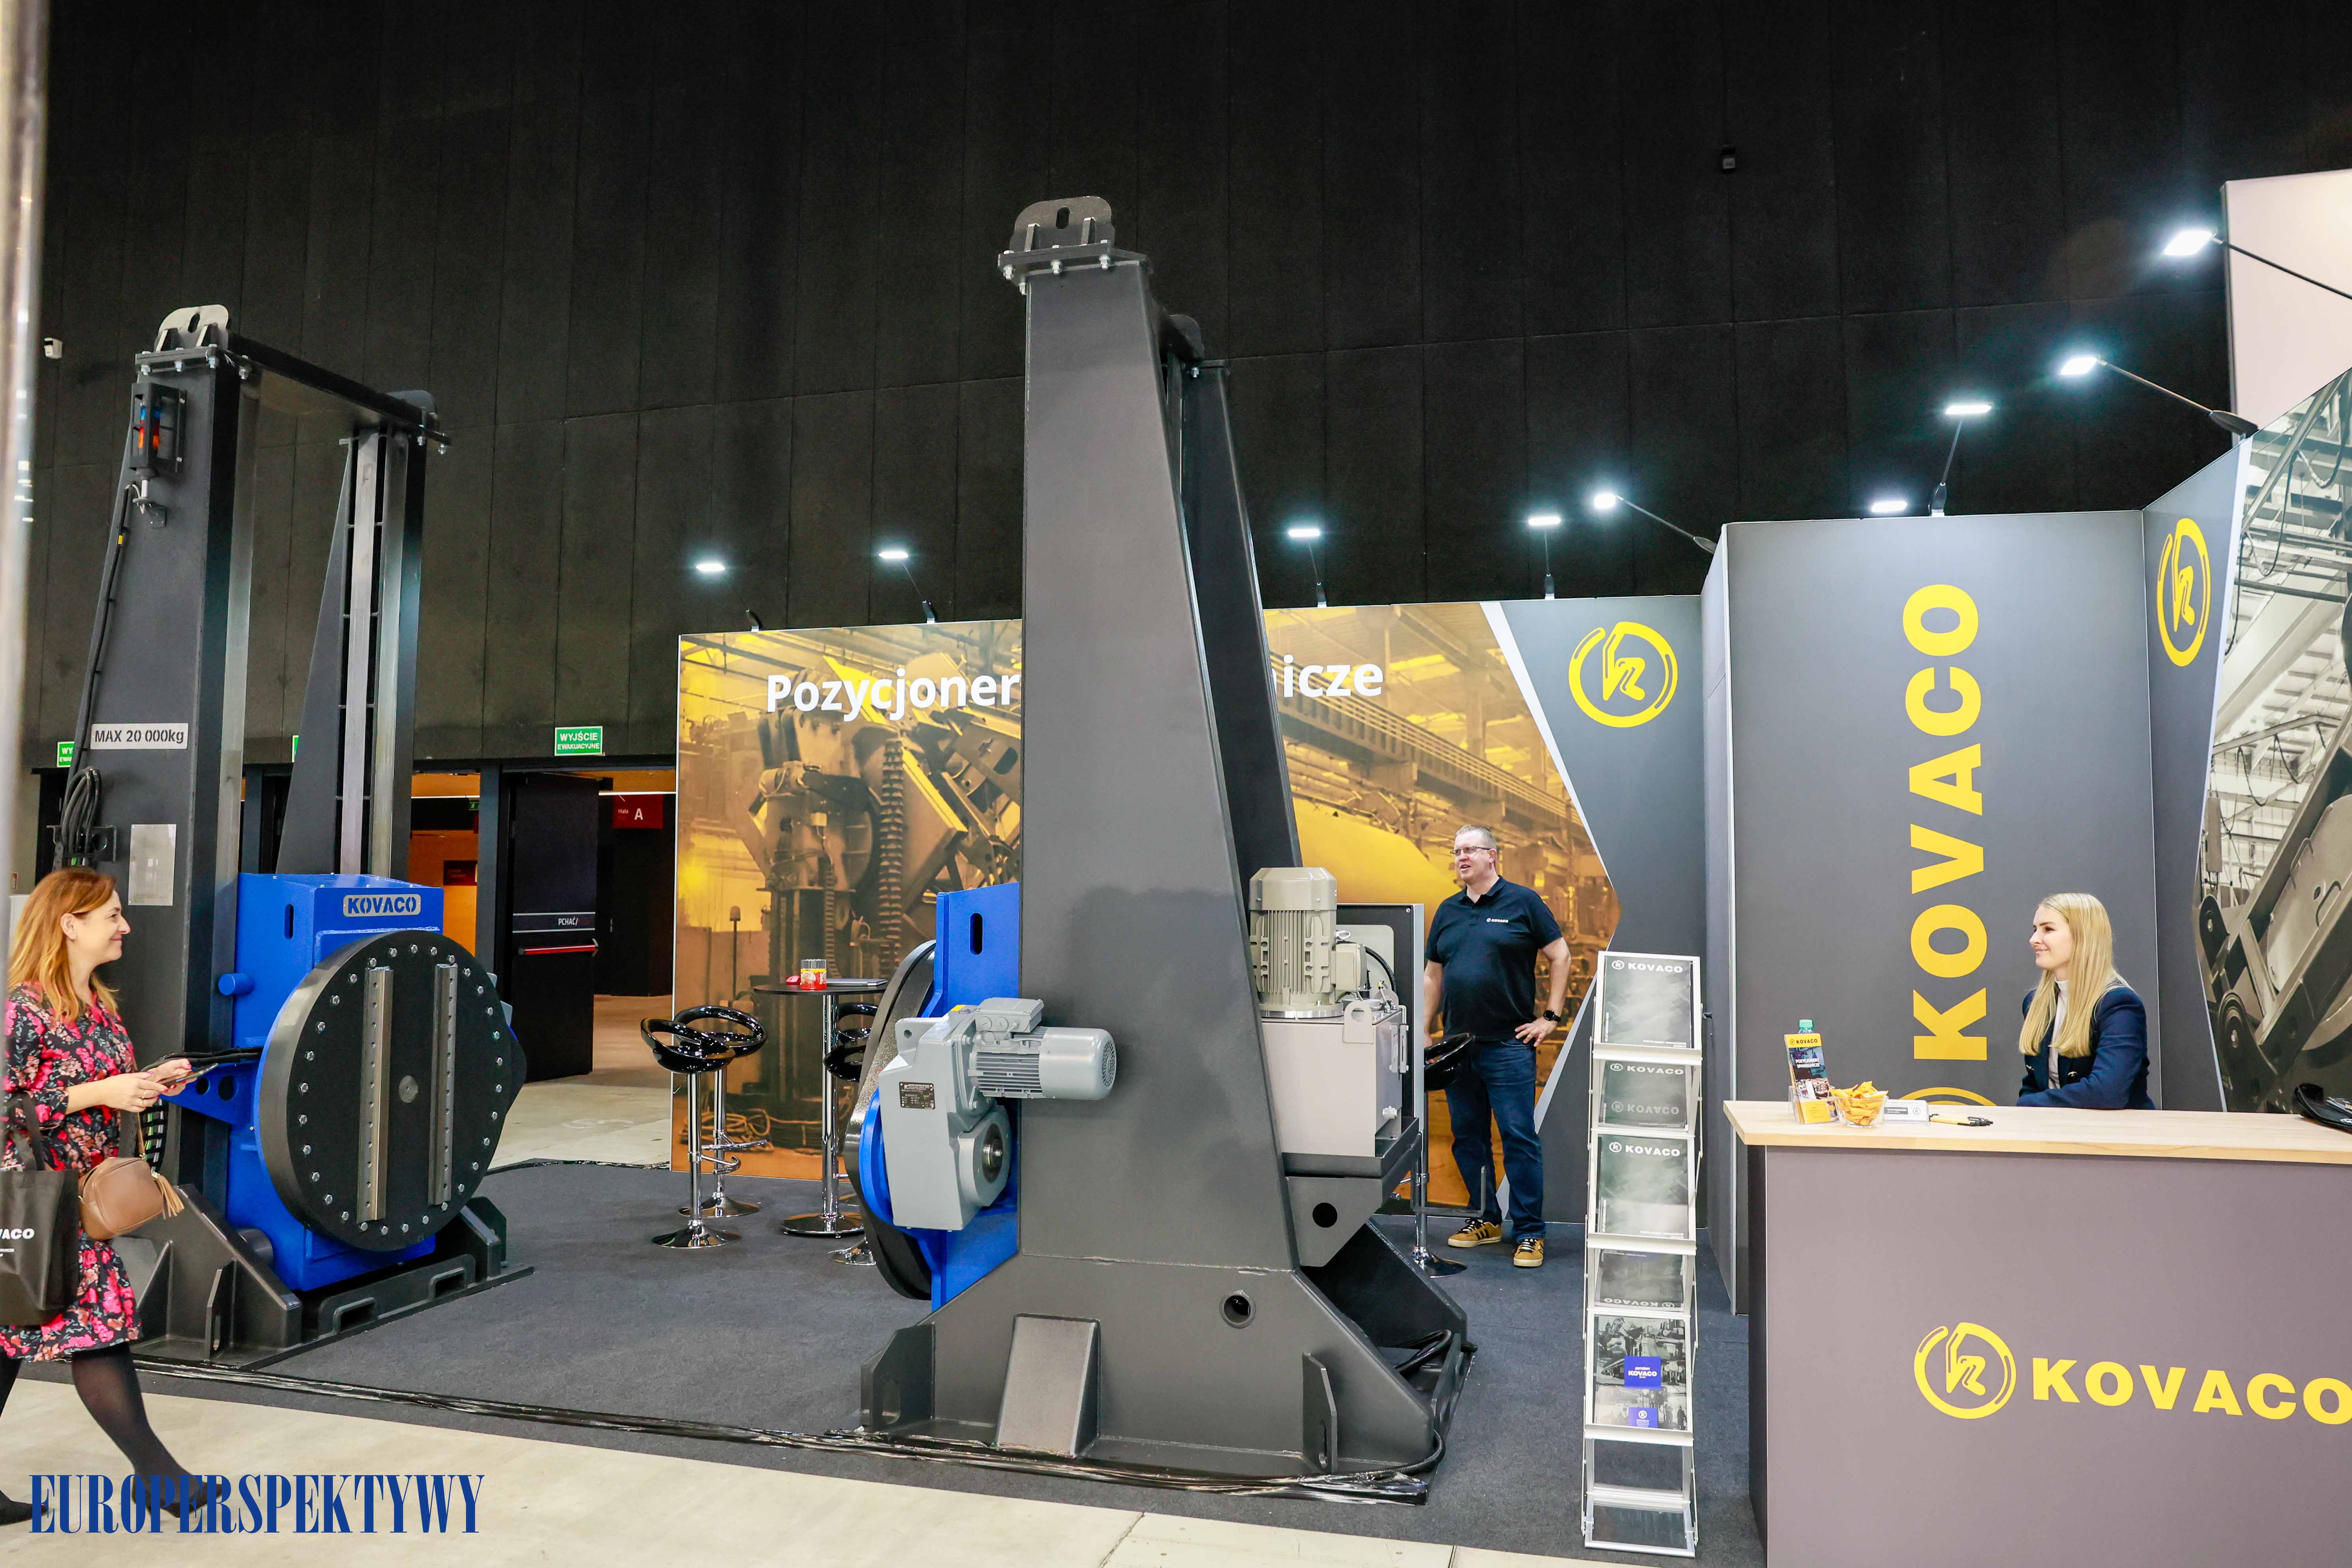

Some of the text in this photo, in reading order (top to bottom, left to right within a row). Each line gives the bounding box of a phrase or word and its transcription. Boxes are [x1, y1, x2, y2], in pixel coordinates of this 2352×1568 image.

[767, 668, 1022, 722] Pozycjoner
[95, 730, 184, 743] MAX 20 000kg
[560, 730, 598, 741] WYJŚCIE
[634, 808, 643, 820] A
[1903, 584, 1988, 1060] KOVACO
[348, 897, 416, 914] KOVACO
[1628, 962, 1683, 973] KOVACO
[1627, 1066, 1684, 1075] KOVACO
[1625, 1145, 1680, 1157] KOVACO
[2033, 1358, 2352, 1425] KOVACO
